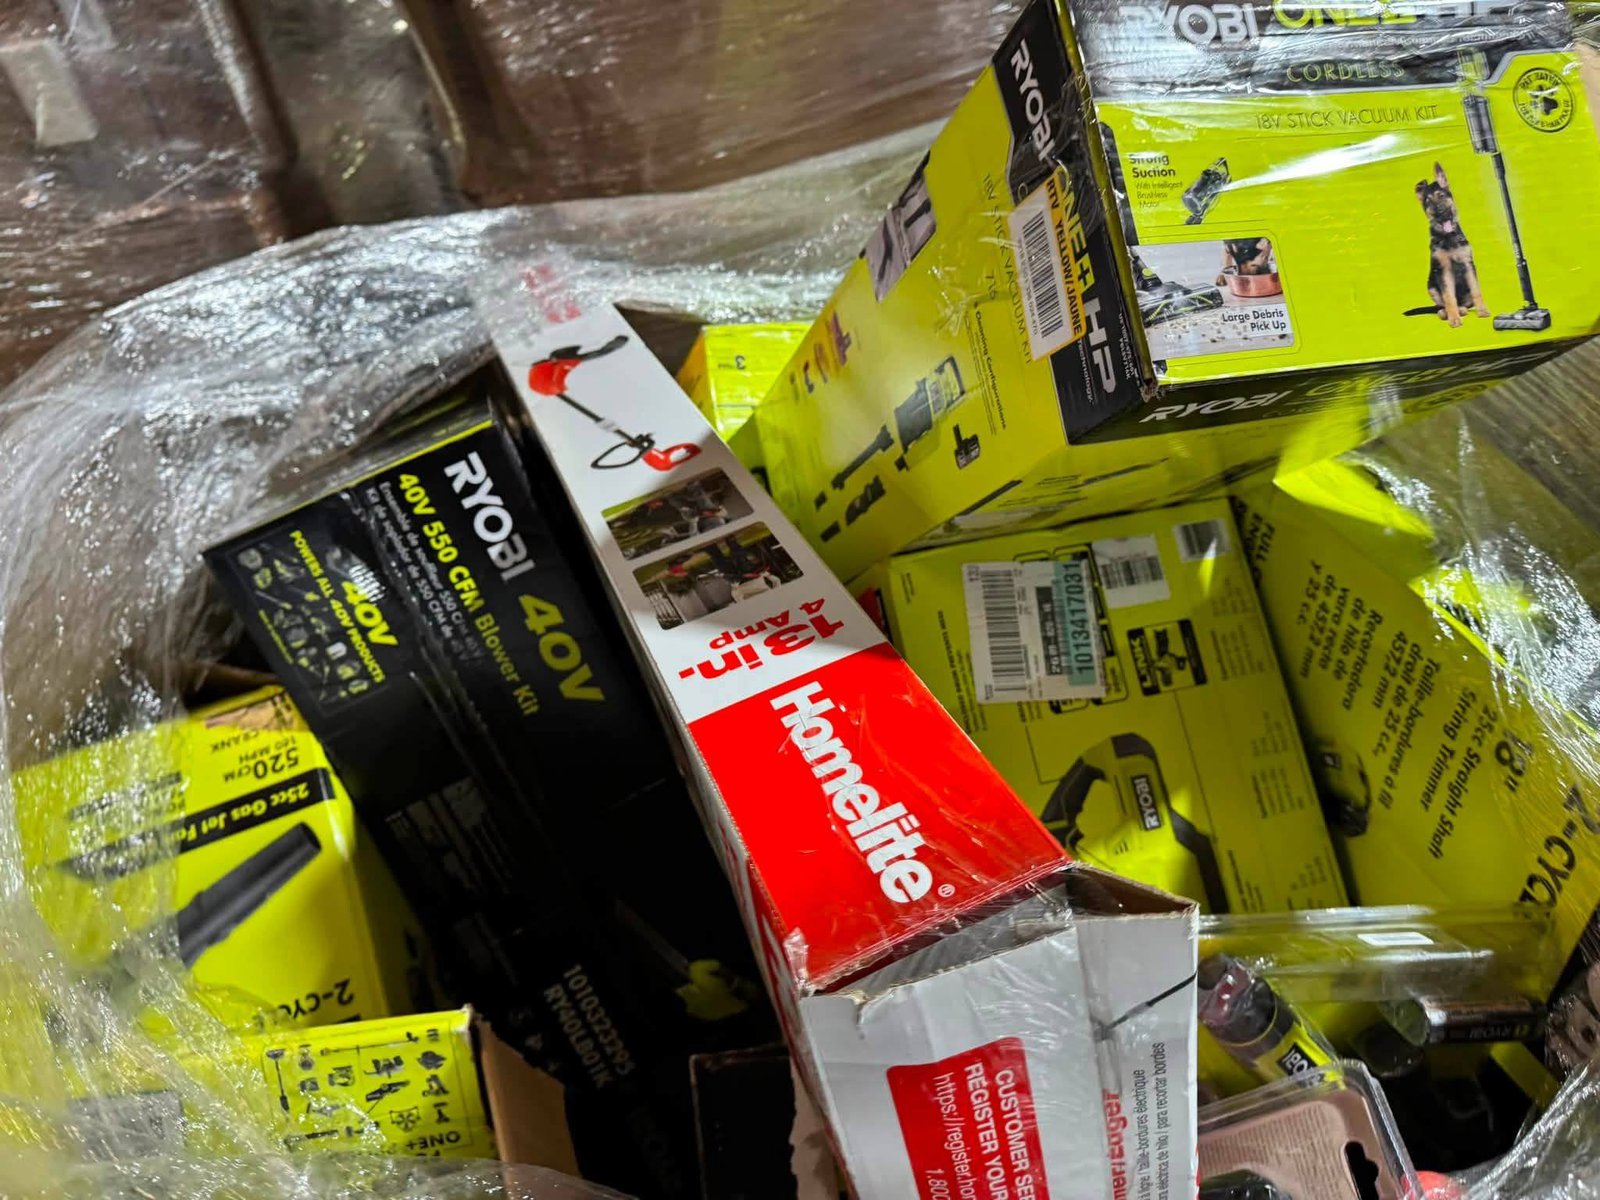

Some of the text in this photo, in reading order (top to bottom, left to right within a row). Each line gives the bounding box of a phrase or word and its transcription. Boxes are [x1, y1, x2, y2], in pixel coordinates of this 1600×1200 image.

[1286, 62, 1405, 83] CORDLESS
[1256, 105, 1438, 129] 18V STICK VACUUM KIT
[1132, 167, 1176, 178] Suction
[1010, 37, 1056, 162] RYOBI
[1085, 297, 1117, 394] HP
[1046, 179, 1083, 337] RTV YELLOW/JAUNE
[1005, 256, 1027, 334] VACUUM
[1222, 308, 1284, 323] Large Debris
[1250, 321, 1287, 332] Pick Up
[1138, 390, 1293, 424] RYOBI
[365, 487, 380, 505] Kit
[373, 503, 388, 520] de
[382, 519, 413, 565] soplador
[406, 563, 421, 580] de
[415, 578, 435, 602] 550
[427, 600, 449, 631] CFM
[439, 623, 454, 639] de
[378, 480, 412, 532] Ensemble
[406, 531, 420, 547] de
[439, 589, 456, 613] 550
[1255, 522, 1276, 563] FULL
[399, 473, 540, 715] 40V 550 CFM Blower Kit
[443, 451, 605, 700] RYOBI 40V
[1304, 577, 1320, 602] 25
[289, 529, 386, 684] POWERS ALL 40V PRODUCTS
[341, 580, 399, 647] 40V
[708, 598, 826, 650] 4 Amp
[1062, 561, 1097, 675] 1013417031
[1299, 573, 1338, 679] de 457,2 mm
[677, 613, 845, 680] 13 in.
[1332, 596, 1366, 682] de hilo de
[1341, 607, 1384, 711] Recortadora
[1401, 641, 1424, 686] droit
[1371, 628, 1409, 710] 457,2 mm
[1392, 682, 1408, 708] de
[1383, 707, 1402, 733] 25
[1386, 657, 1441, 777] Taille-bordures
[238, 745, 272, 766] MPH
[1419, 687, 1478, 812] String Trimmer
[269, 781, 311, 808] 25cc
[768, 680, 934, 904] Homelite
[1134, 777, 1159, 830] RYOBI
[1426, 703, 1498, 861] 25cc Straight Shaft
[201, 812, 228, 835] Jet
[230, 799, 268, 822] Gas
[1150, 1041, 1167, 1075] bordes
[963, 1060, 1000, 1156] REGISTER
[1132, 1068, 1150, 1115] électrique
[1153, 1077, 1169, 1111] recortar
[406, 1130, 461, 1150] ONE+
[994, 1067, 1031, 1174] CUSTOMER
[1136, 1114, 1151, 1173] taille-bordures
[1155, 1134, 1169, 1151] hilo
[1156, 1110, 1171, 1131] para
[1157, 1150, 1169, 1161] de
